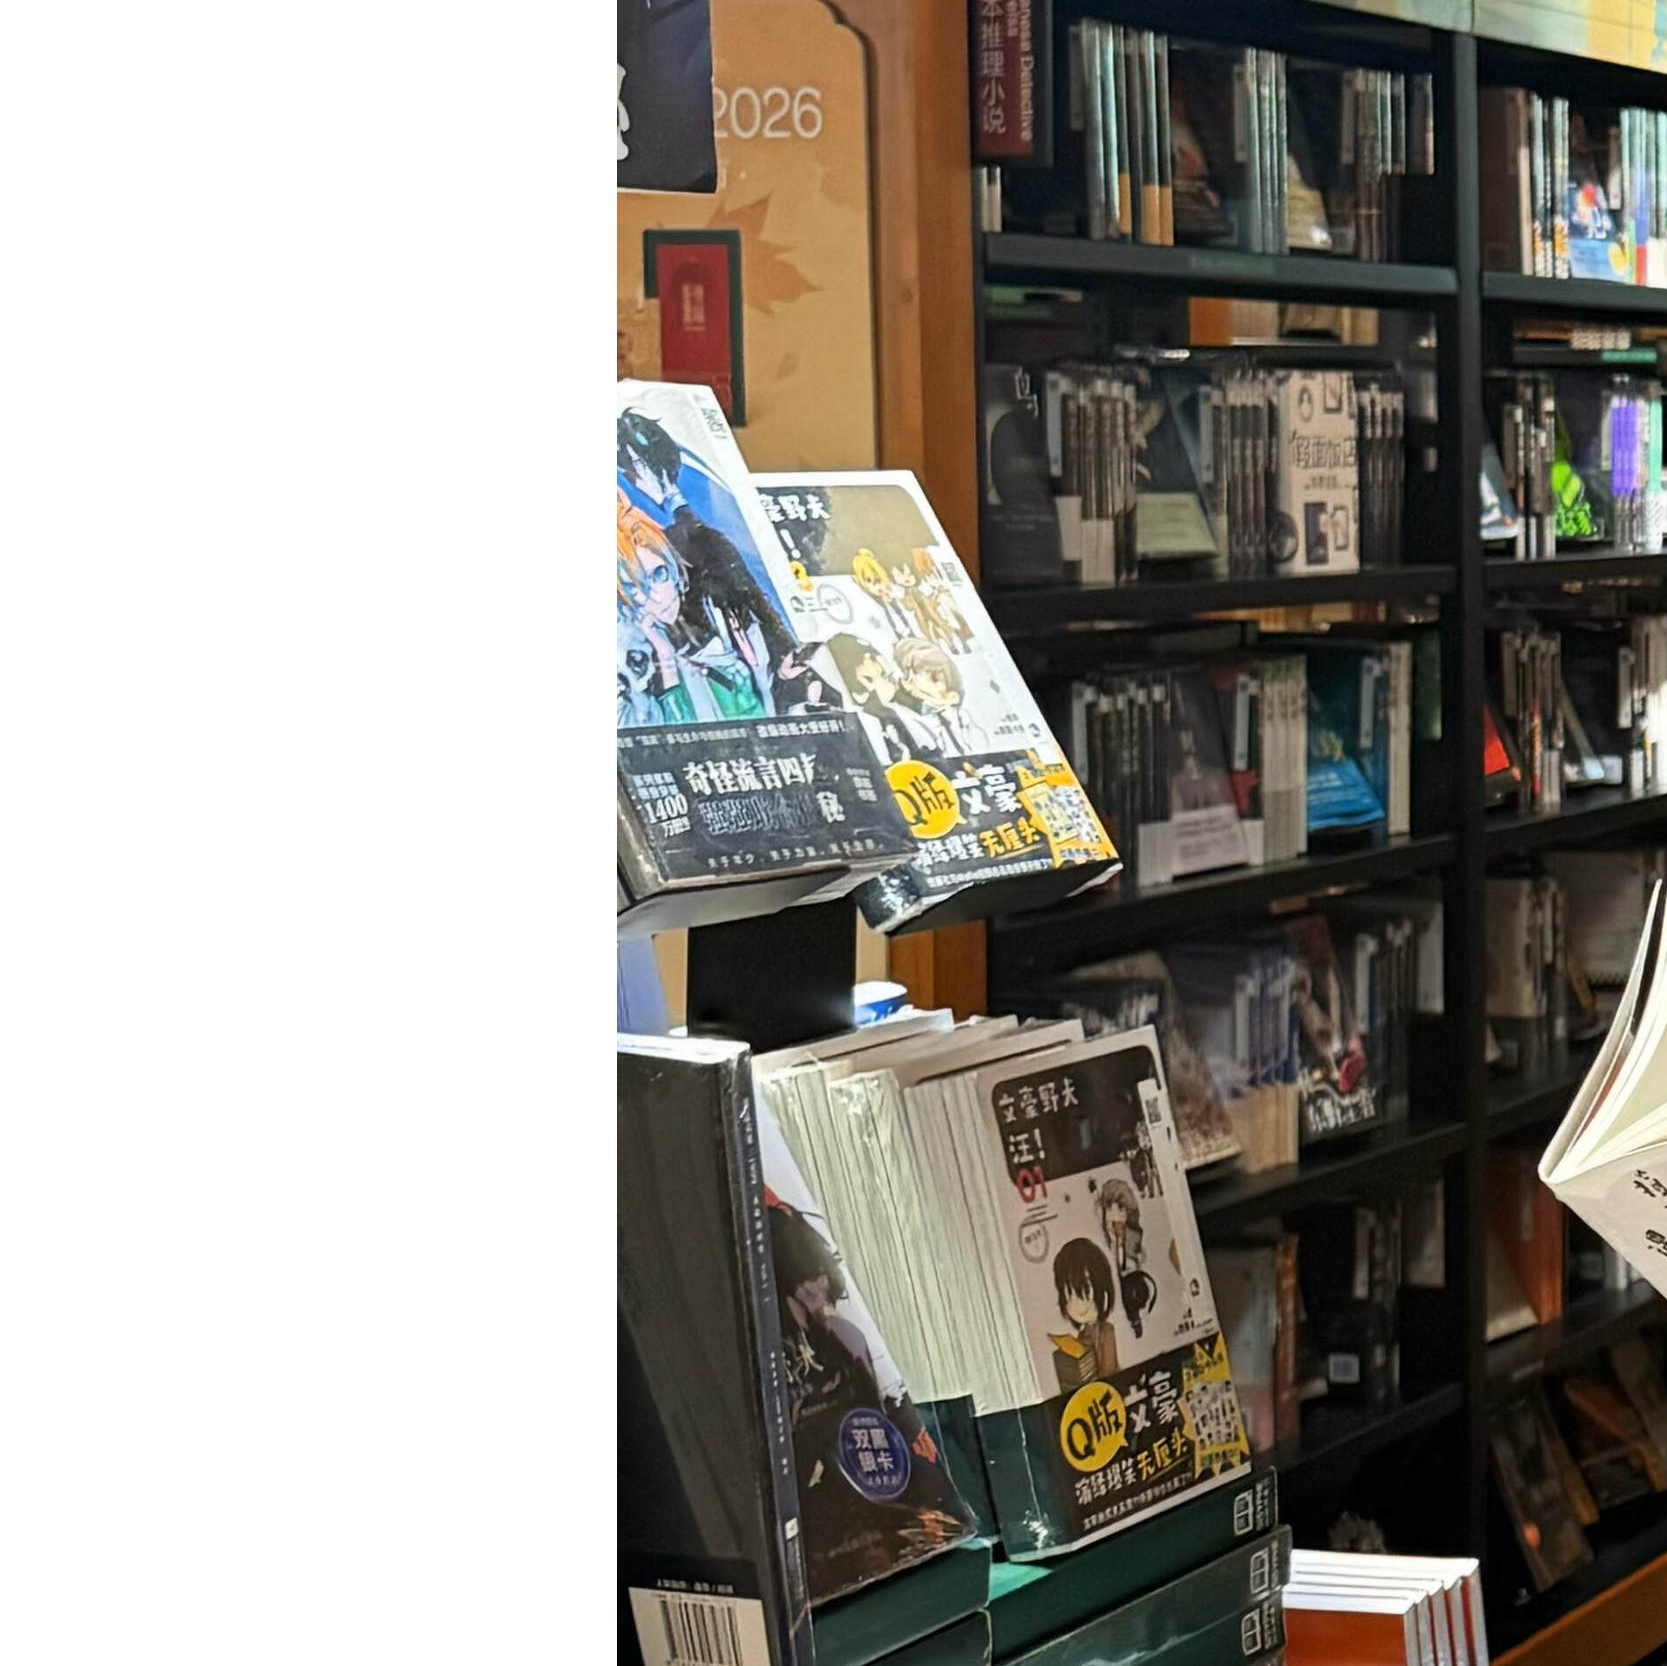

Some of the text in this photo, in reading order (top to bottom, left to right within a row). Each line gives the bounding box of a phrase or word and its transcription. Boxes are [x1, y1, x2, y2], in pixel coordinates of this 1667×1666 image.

[644, 794, 689, 824] 1400
[1067, 1370, 1180, 1462] Q版 文豪
